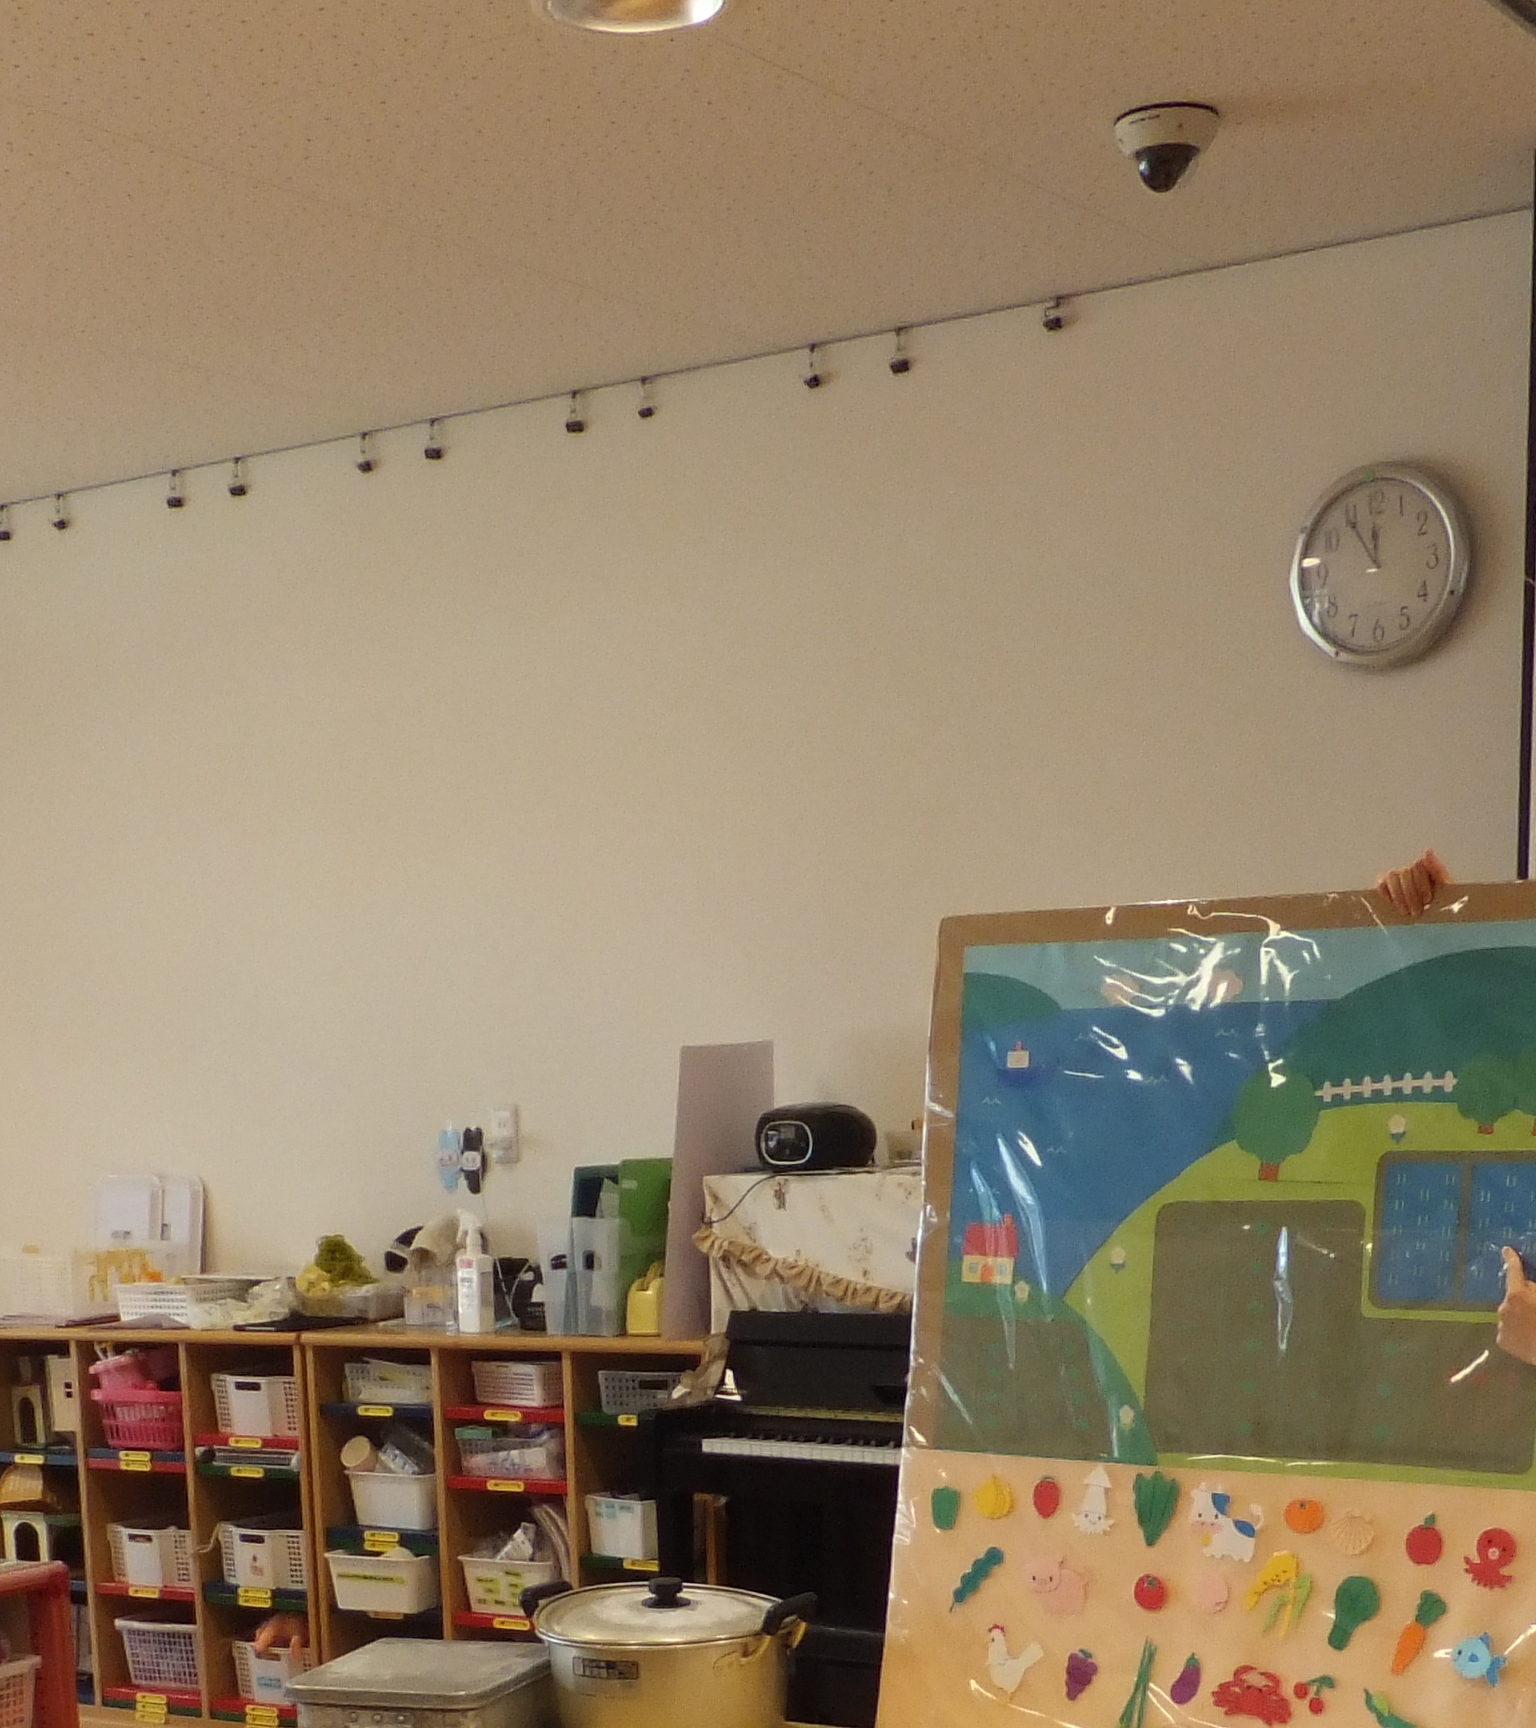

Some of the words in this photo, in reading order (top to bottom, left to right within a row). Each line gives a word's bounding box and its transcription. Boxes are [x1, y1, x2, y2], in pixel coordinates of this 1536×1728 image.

[1369, 490, 1384, 515] 12
[1416, 510, 1428, 536] 2
[1324, 528, 1340, 552] 10
[1426, 544, 1439, 569] 3
[1317, 563, 1329, 588] 9
[1417, 580, 1428, 602] 4
[1326, 596, 1339, 618] 8
[1398, 606, 1410, 630] 5
[1349, 613, 1358, 637] 7
[1372, 618, 1385, 642] 6
